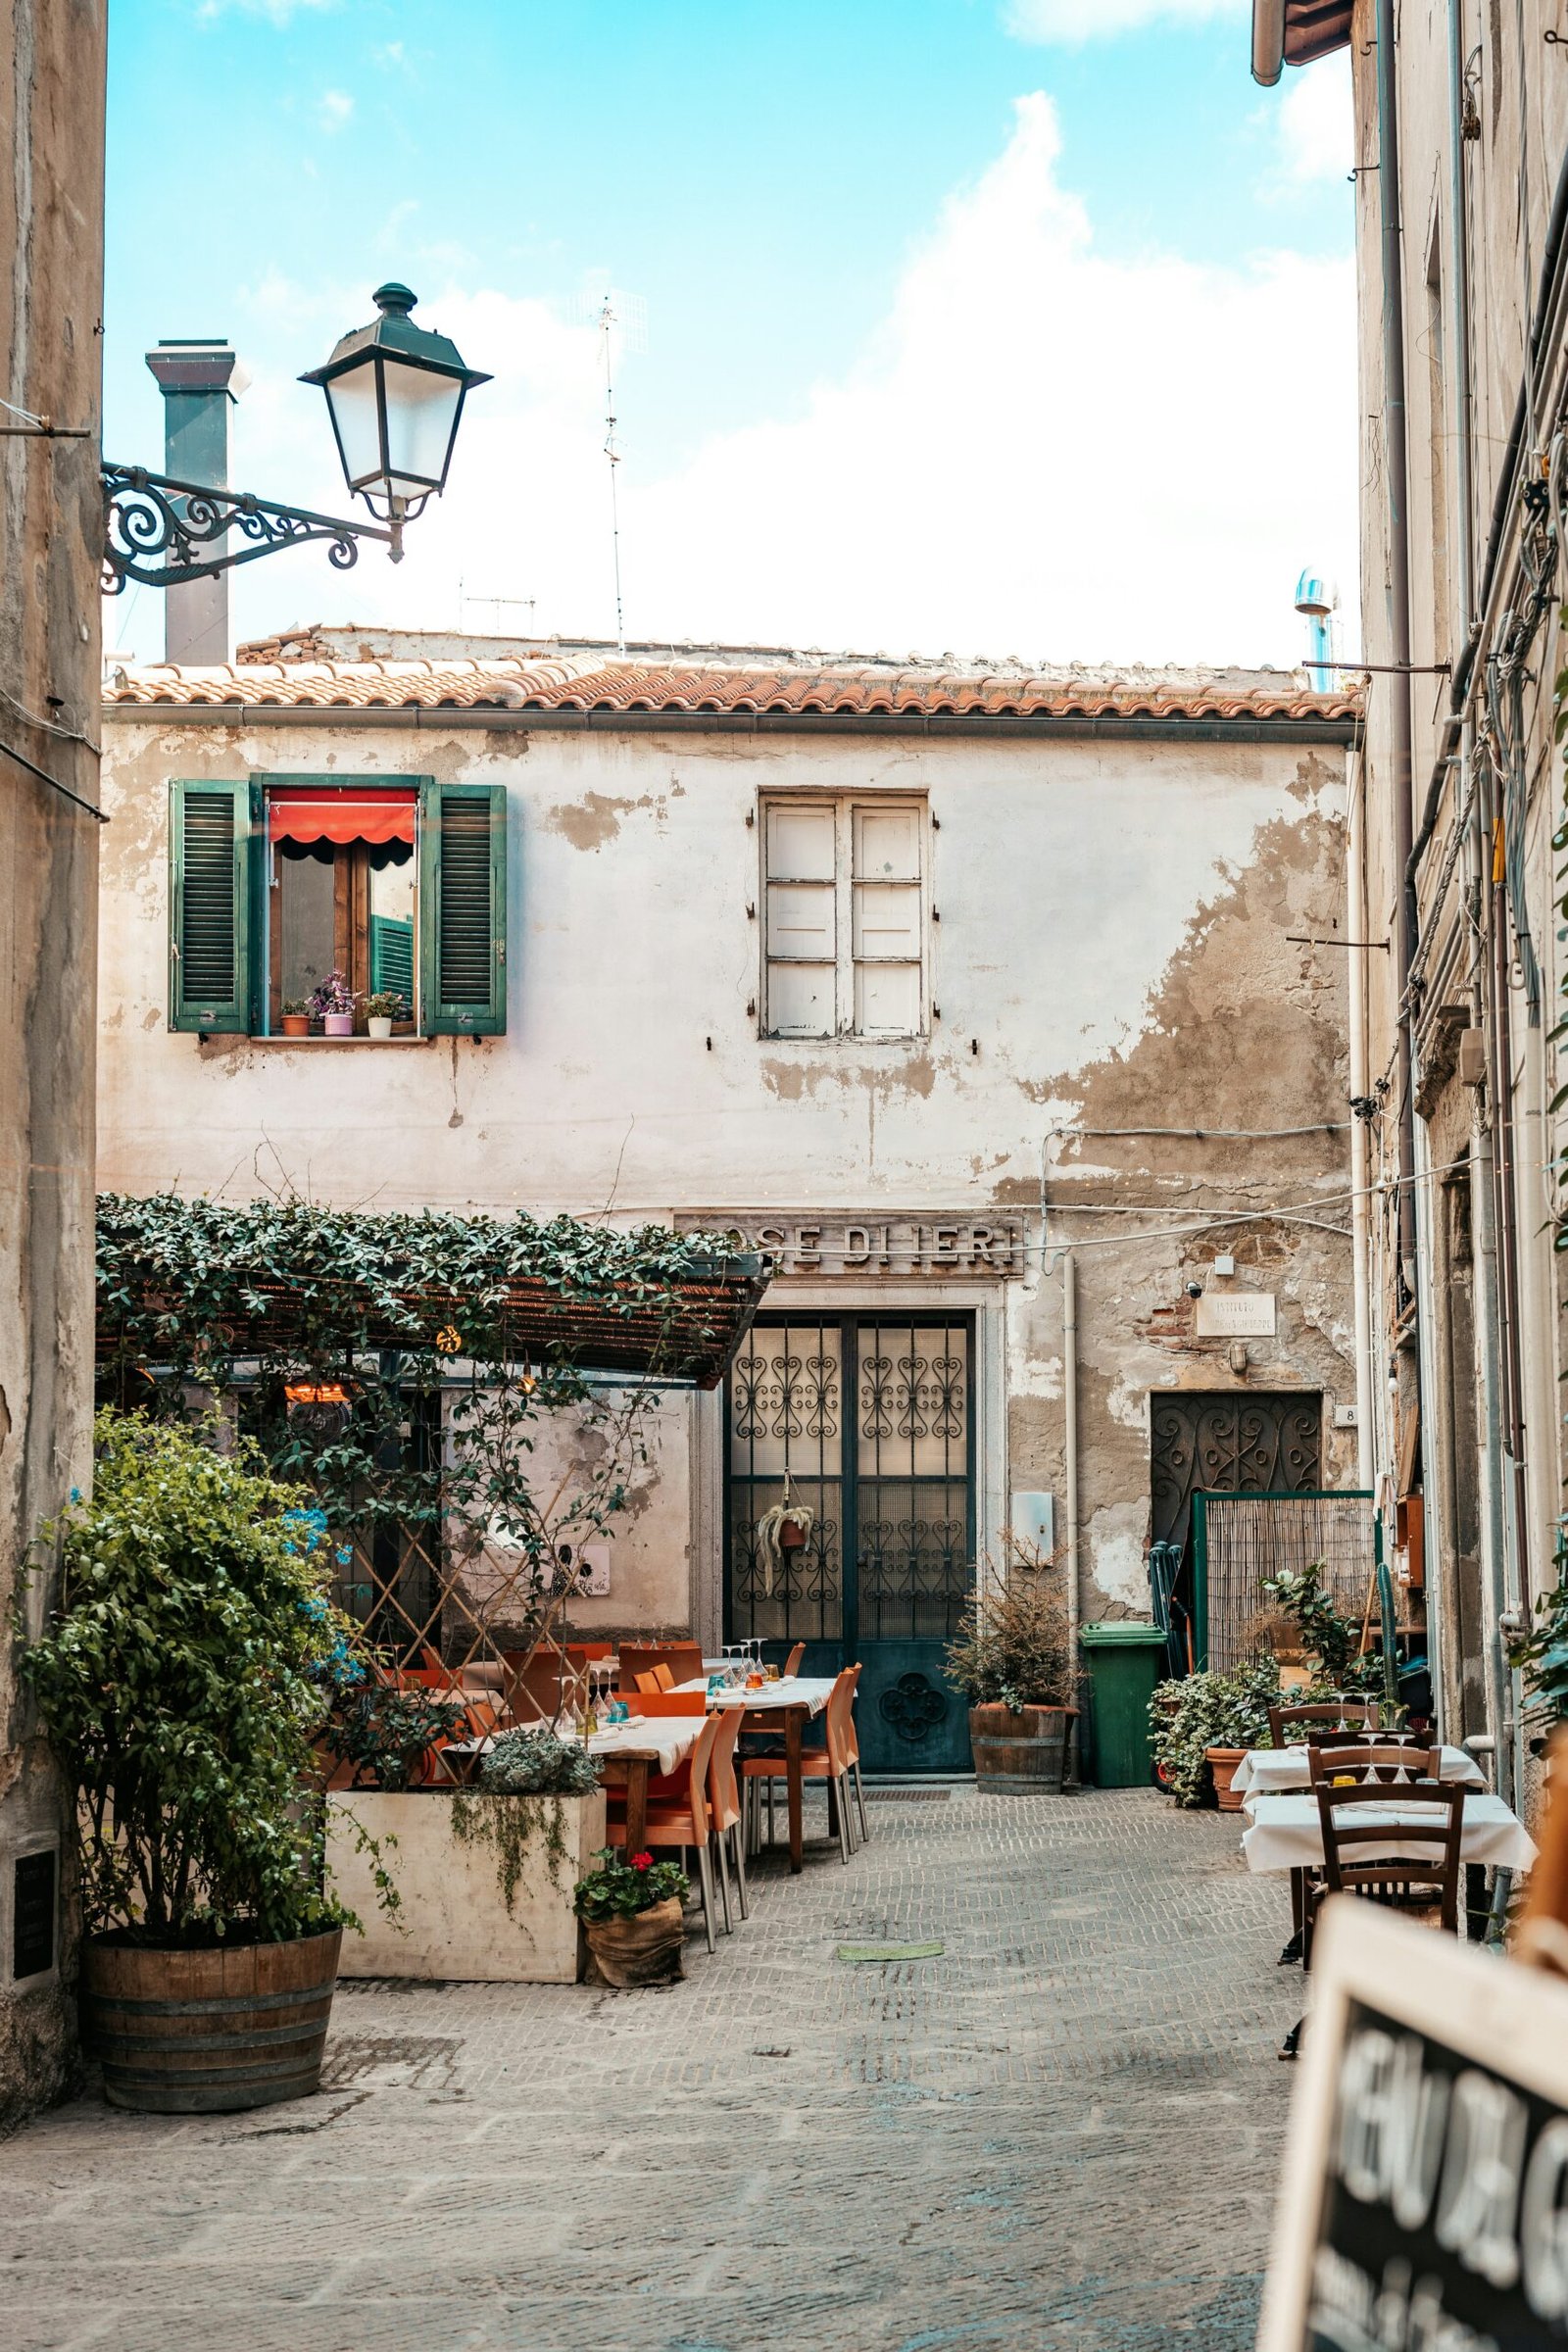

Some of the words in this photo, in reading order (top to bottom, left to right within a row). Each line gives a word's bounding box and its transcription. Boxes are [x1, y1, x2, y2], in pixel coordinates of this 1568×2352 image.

[844, 1226, 888, 1262] DI
[911, 1225, 1013, 1263] IERI
[1347, 1410, 1354, 1421] 8
